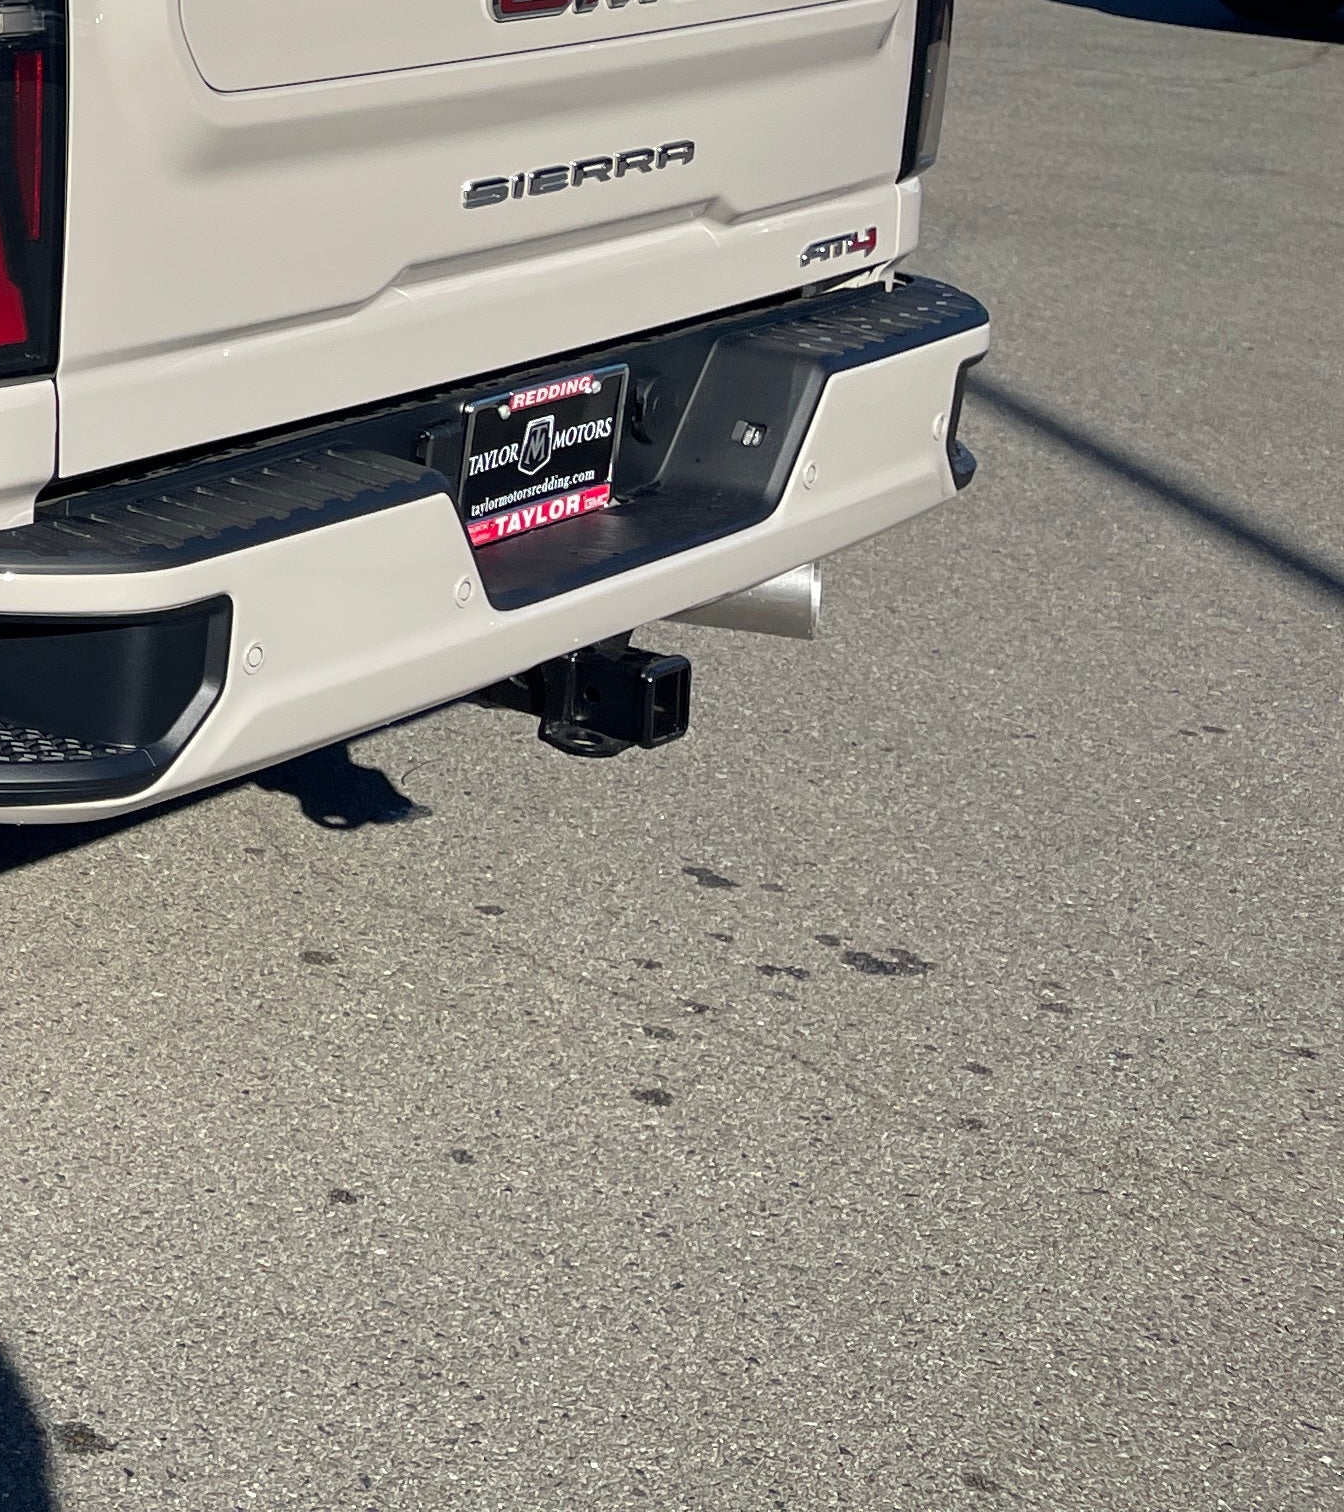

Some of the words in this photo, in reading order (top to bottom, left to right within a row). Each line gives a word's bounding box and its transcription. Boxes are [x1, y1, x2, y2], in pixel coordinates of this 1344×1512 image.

[462, 140, 696, 209] SIERRA
[799, 226, 877, 268] AT4
[512, 376, 592, 409] REDDING
[469, 443, 519, 476] TAYLOR
[553, 417, 613, 450] MOTORS
[471, 469, 595, 518] taylormotorsredding.com
[495, 494, 581, 536] TAYLOR
